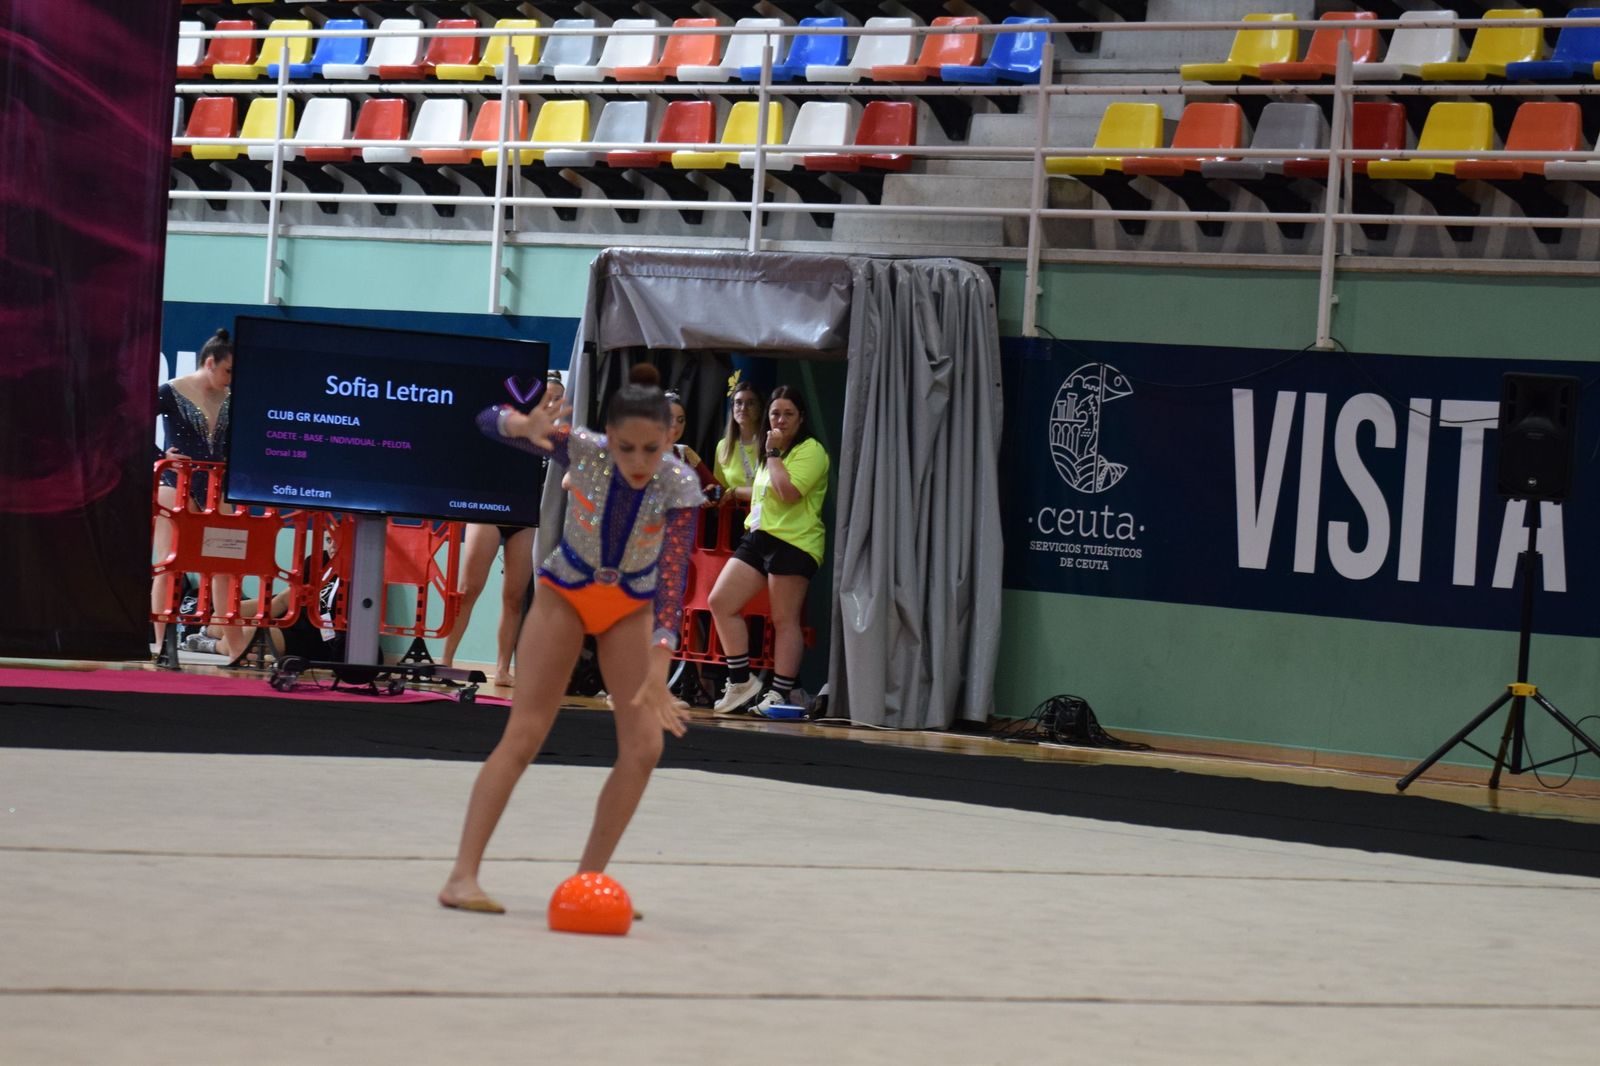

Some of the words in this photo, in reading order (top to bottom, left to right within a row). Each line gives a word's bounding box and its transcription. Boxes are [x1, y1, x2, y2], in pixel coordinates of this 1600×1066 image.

[325, 375, 379, 398] Sofia
[386, 380, 454, 405] Letran
[267, 409, 294, 421] CLUB
[296, 412, 311, 423] GR
[313, 413, 360, 426] KANDELA
[266, 430, 297, 440] CADETE
[304, 433, 324, 443] BASE
[330, 435, 375, 447] INDIVIDUAL
[382, 439, 411, 450] PELOTA
[265, 448, 291, 458] Dorsal
[272, 484, 298, 496] Sofia
[299, 487, 332, 499] Letran
[449, 500, 467, 509] CLUB
[479, 503, 511, 512] KANDELA
[1030, 541, 1081, 553] SERVICIOS
[1083, 544, 1142, 558] TURÍSTICOS
[1060, 557, 1074, 568] DE
[1075, 559, 1109, 571] CEUTA
